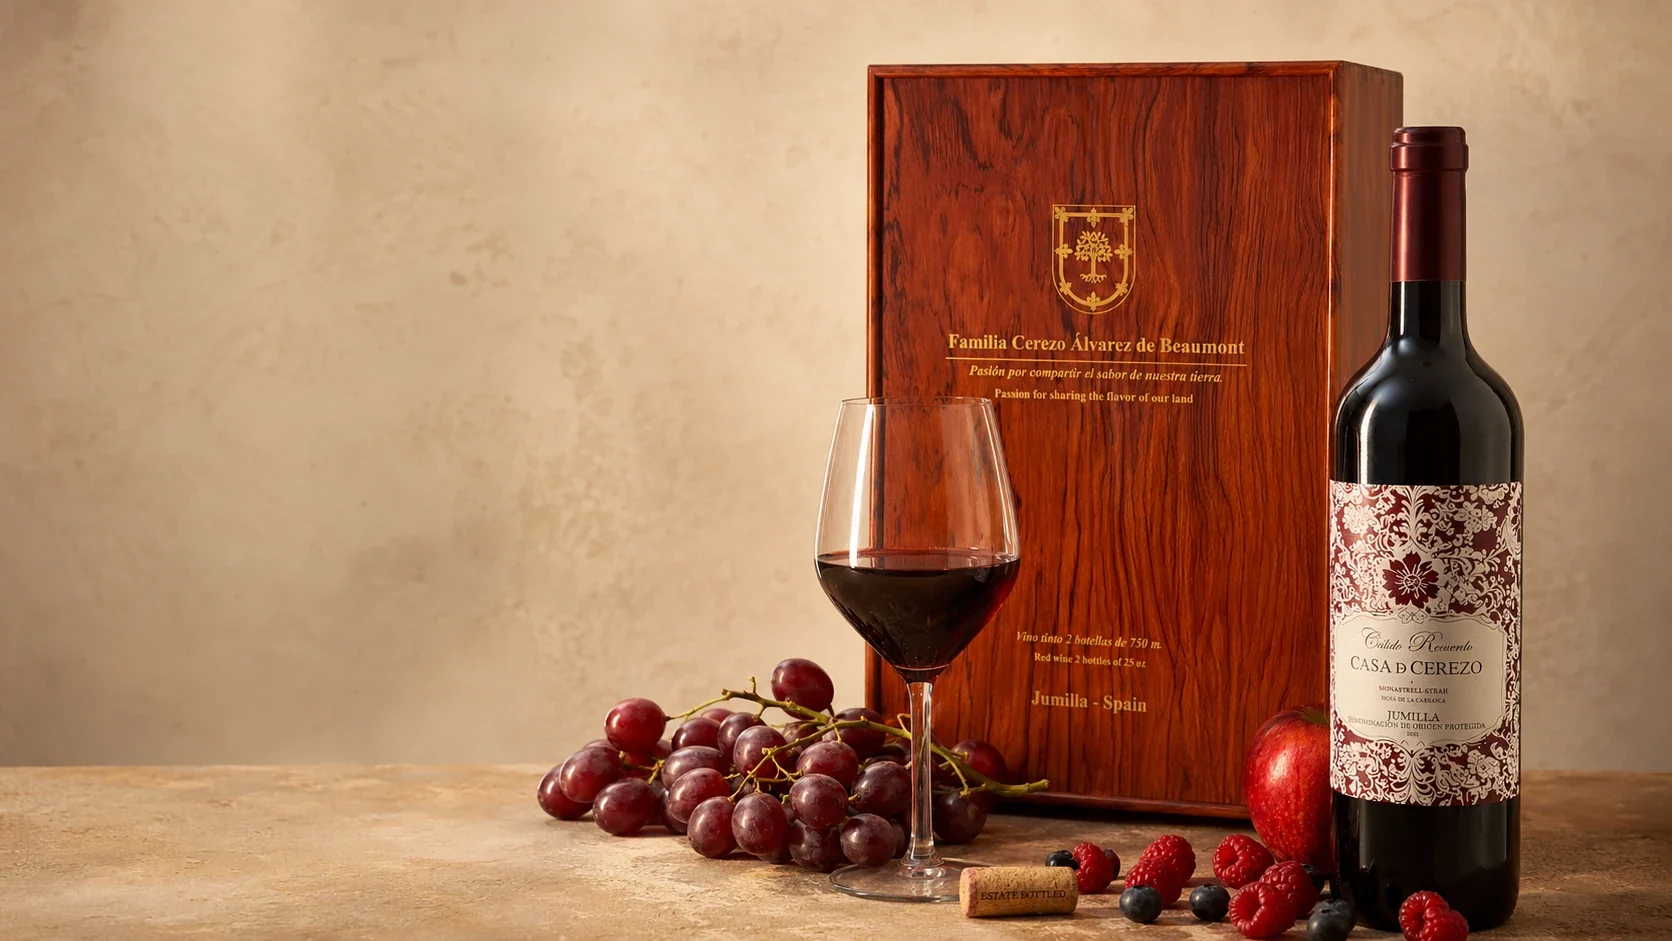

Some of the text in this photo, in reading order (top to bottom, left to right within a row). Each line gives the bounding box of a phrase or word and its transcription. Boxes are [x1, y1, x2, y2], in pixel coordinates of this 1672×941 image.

[948, 332, 1246, 355] Familia Cerezo Álvarez de Beaumont
[969, 364, 1006, 377] Pasión
[1007, 368, 1027, 380] por
[1029, 367, 1082, 381] compartir
[1084, 368, 1094, 379] el
[1096, 369, 1127, 380] sabor
[1129, 369, 1143, 381] de
[1145, 371, 1187, 382] nuestra
[994, 388, 1194, 404] Passion for sharing the flavor of our land
[1016, 631, 1039, 642] Vino
[1040, 632, 1063, 644] tinto
[1065, 634, 1073, 645] 2
[1074, 635, 1113, 646] botellas
[1114, 637, 1128, 648] de
[1129, 638, 1149, 649] 750
[1034, 652, 1051, 663] Red
[1053, 654, 1073, 664] wine
[1074, 655, 1081, 664] 2
[1082, 656, 1111, 667] bottles
[1112, 658, 1122, 667] of
[1123, 658, 1135, 668] 25
[1350, 655, 1392, 674] CASA
[1410, 660, 1483, 676] CEREZO
[1031, 690, 1089, 709] Jumilla
[1103, 695, 1148, 715] Spain
[1387, 710, 1441, 723] JUMILLA
[1444, 722, 1487, 732] PROTEGIDA
[981, 889, 1067, 901] ESTATE BOTTLED
